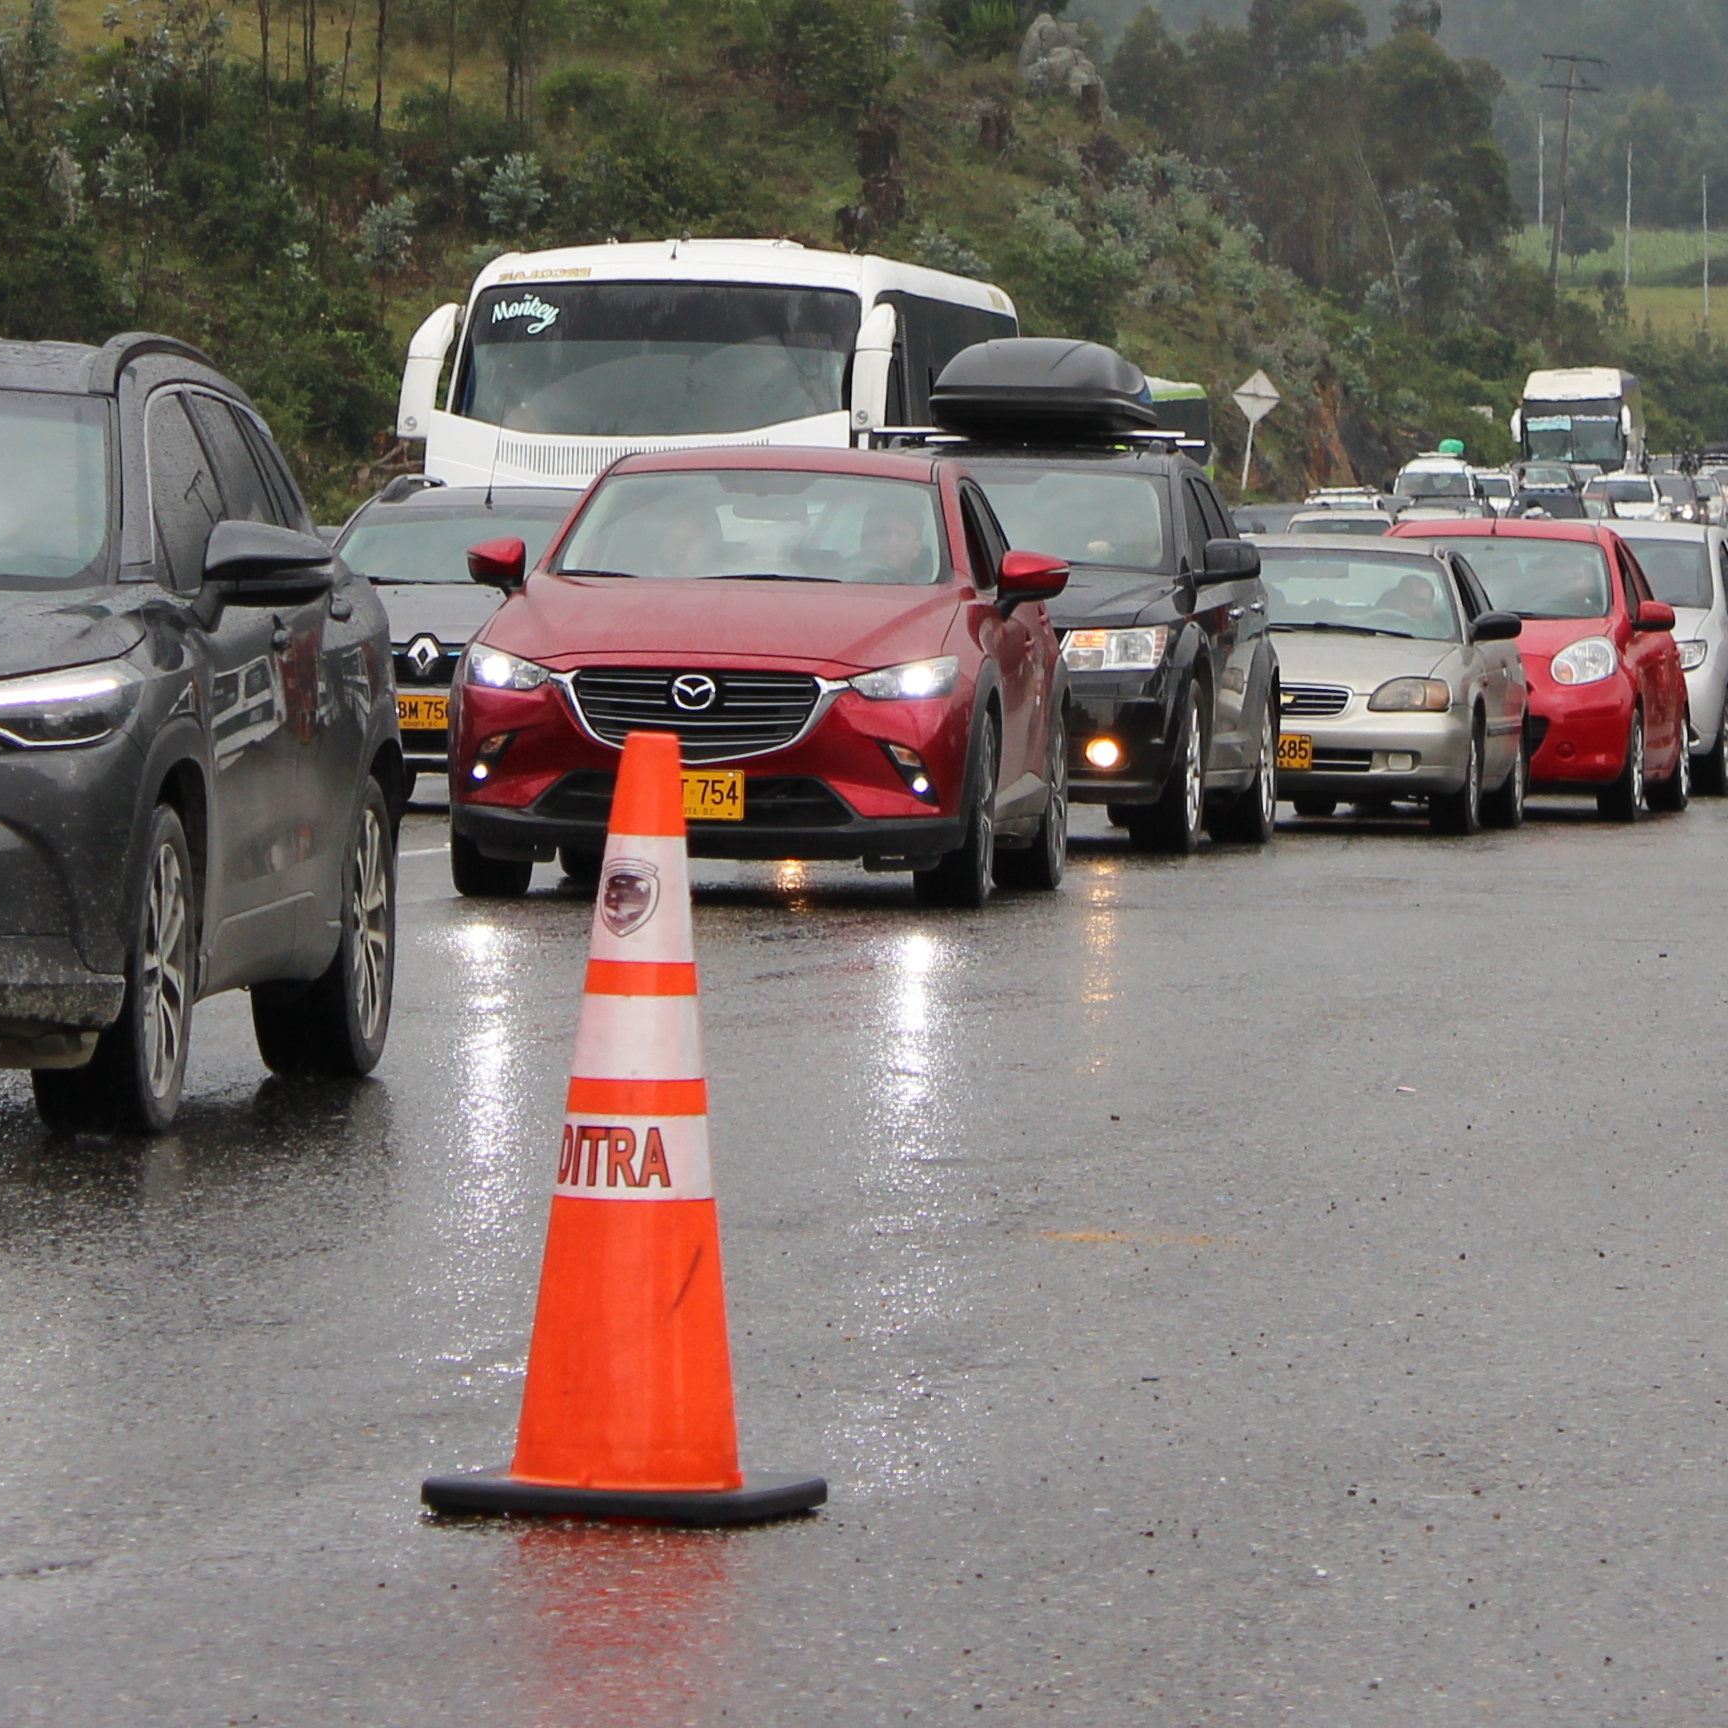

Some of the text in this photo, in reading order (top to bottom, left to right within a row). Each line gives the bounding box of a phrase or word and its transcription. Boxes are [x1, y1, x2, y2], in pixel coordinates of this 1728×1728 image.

[492, 296, 560, 334] Monkey
[398, 701, 419, 719] BM
[1278, 740, 1309, 760] 685
[696, 779, 739, 806] 754
